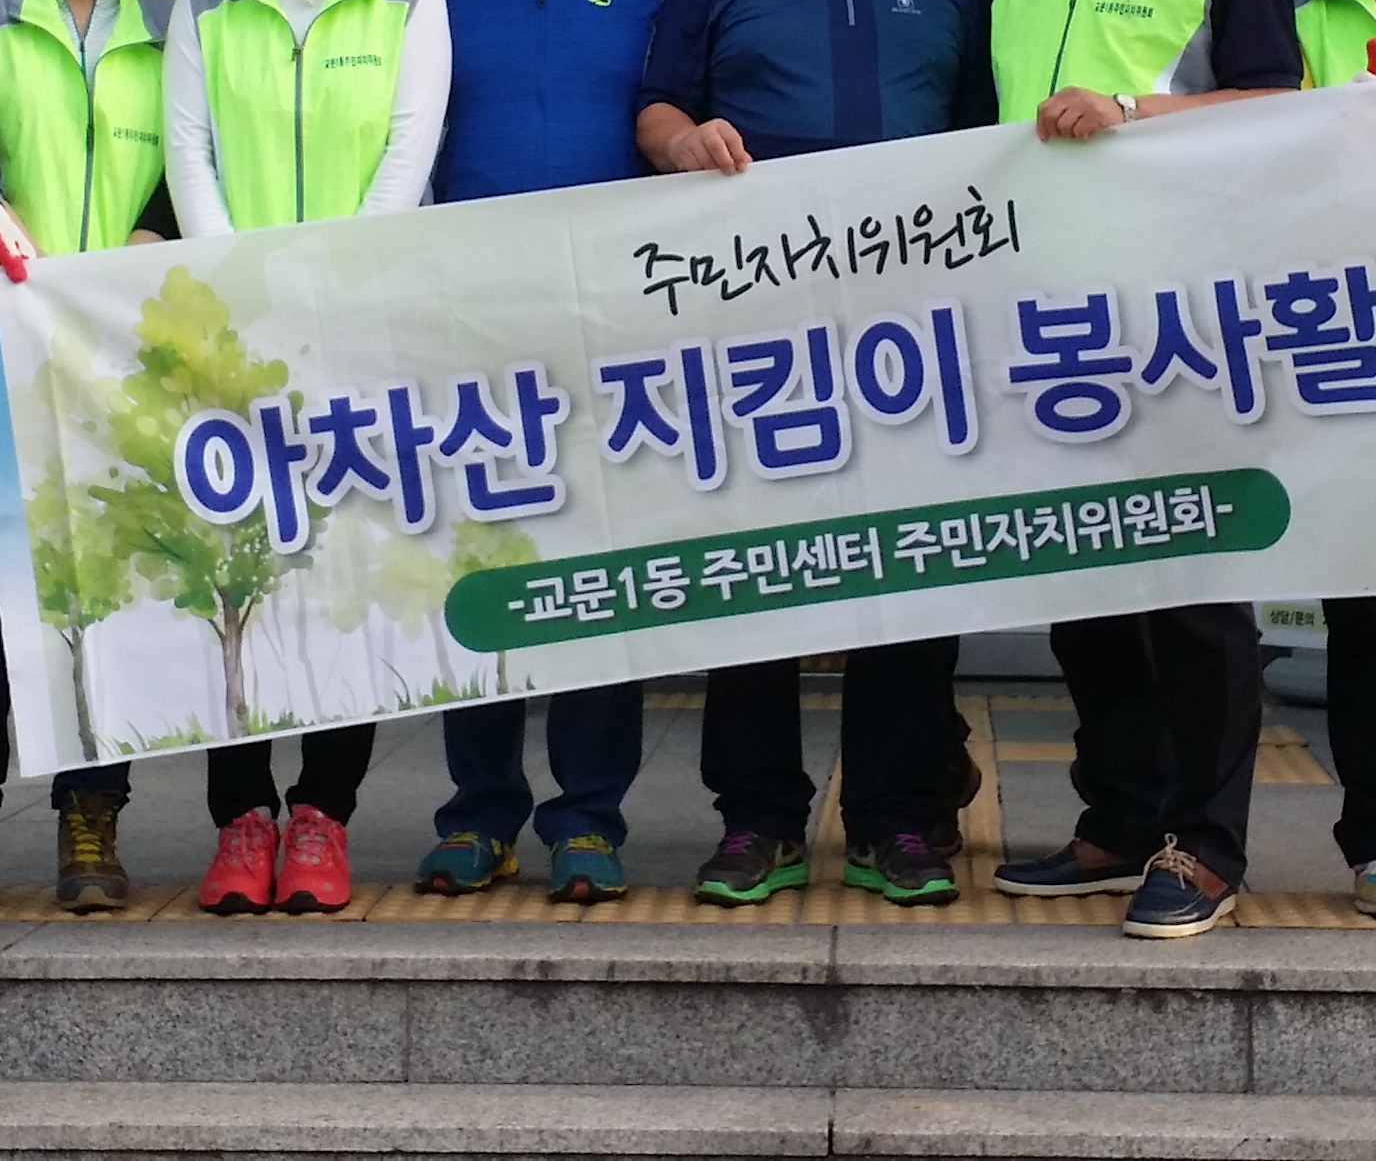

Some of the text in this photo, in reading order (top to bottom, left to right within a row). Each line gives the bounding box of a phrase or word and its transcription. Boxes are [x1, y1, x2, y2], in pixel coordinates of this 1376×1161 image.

[633, 185, 1021, 316] 주민자치위원회
[181, 367, 562, 546] 아차산
[599, 306, 970, 482] 지킴이
[700, 526, 884, 602] 주민센터
[894, 483, 1234, 574] 주민자치위원회-
